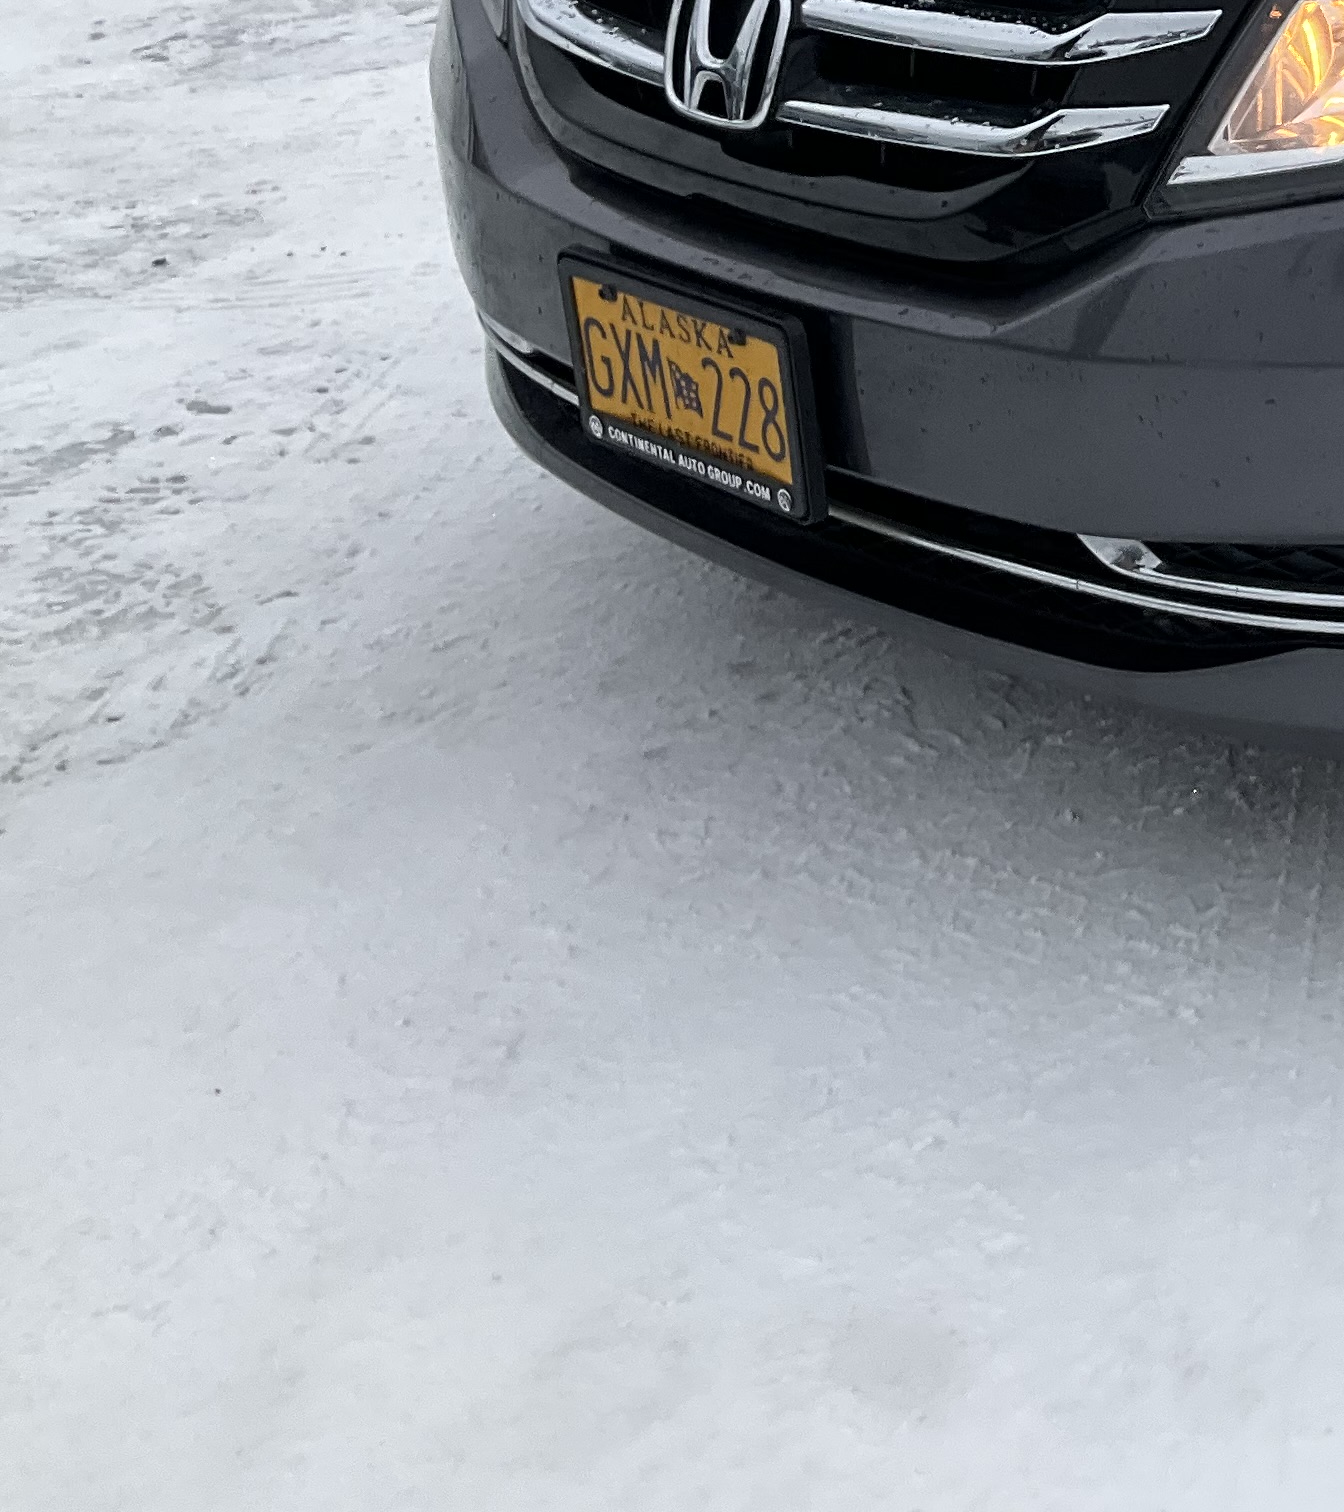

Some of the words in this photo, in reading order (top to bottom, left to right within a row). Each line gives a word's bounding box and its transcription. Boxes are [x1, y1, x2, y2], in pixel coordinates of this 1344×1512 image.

[621, 294, 734, 358] ALASKA
[583, 316, 672, 419] GXM
[701, 357, 786, 462] 228
[608, 425, 676, 464] CONTINENTAL
[678, 454, 706, 475] AUTO
